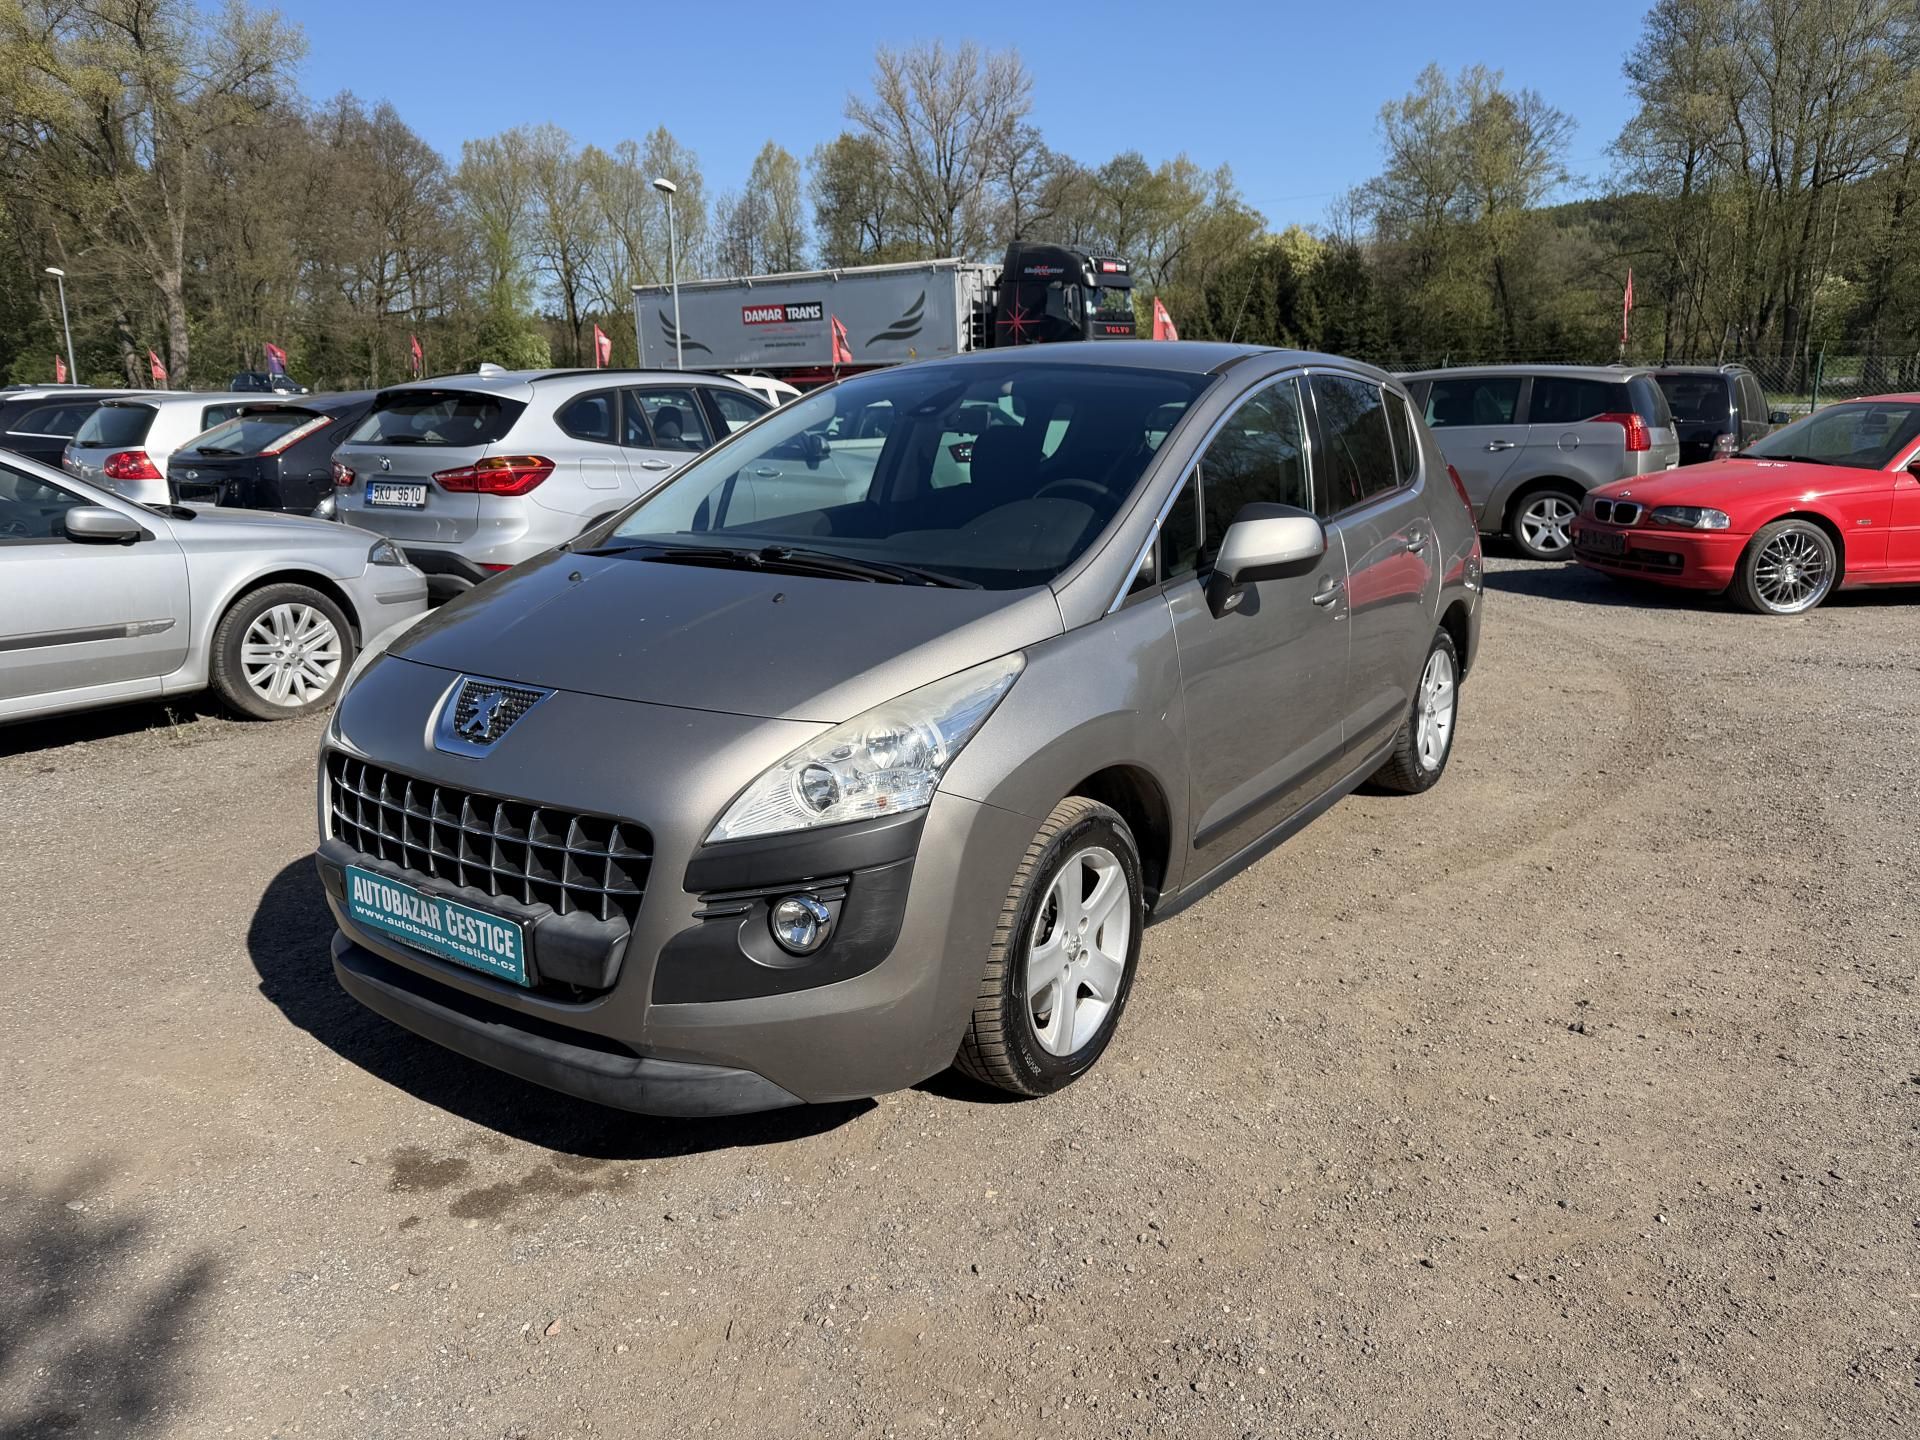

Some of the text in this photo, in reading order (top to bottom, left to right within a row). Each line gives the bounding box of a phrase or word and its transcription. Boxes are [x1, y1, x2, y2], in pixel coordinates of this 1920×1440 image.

[743, 305, 821, 323] DAMAR TRANS
[1105, 325, 1130, 334] VOLVO
[397, 486, 421, 502] 9610
[353, 876, 442, 931] AUTOBAZAR
[445, 905, 516, 960] ČESTICE
[355, 904, 517, 973] www.autobazar-cestice.cz
